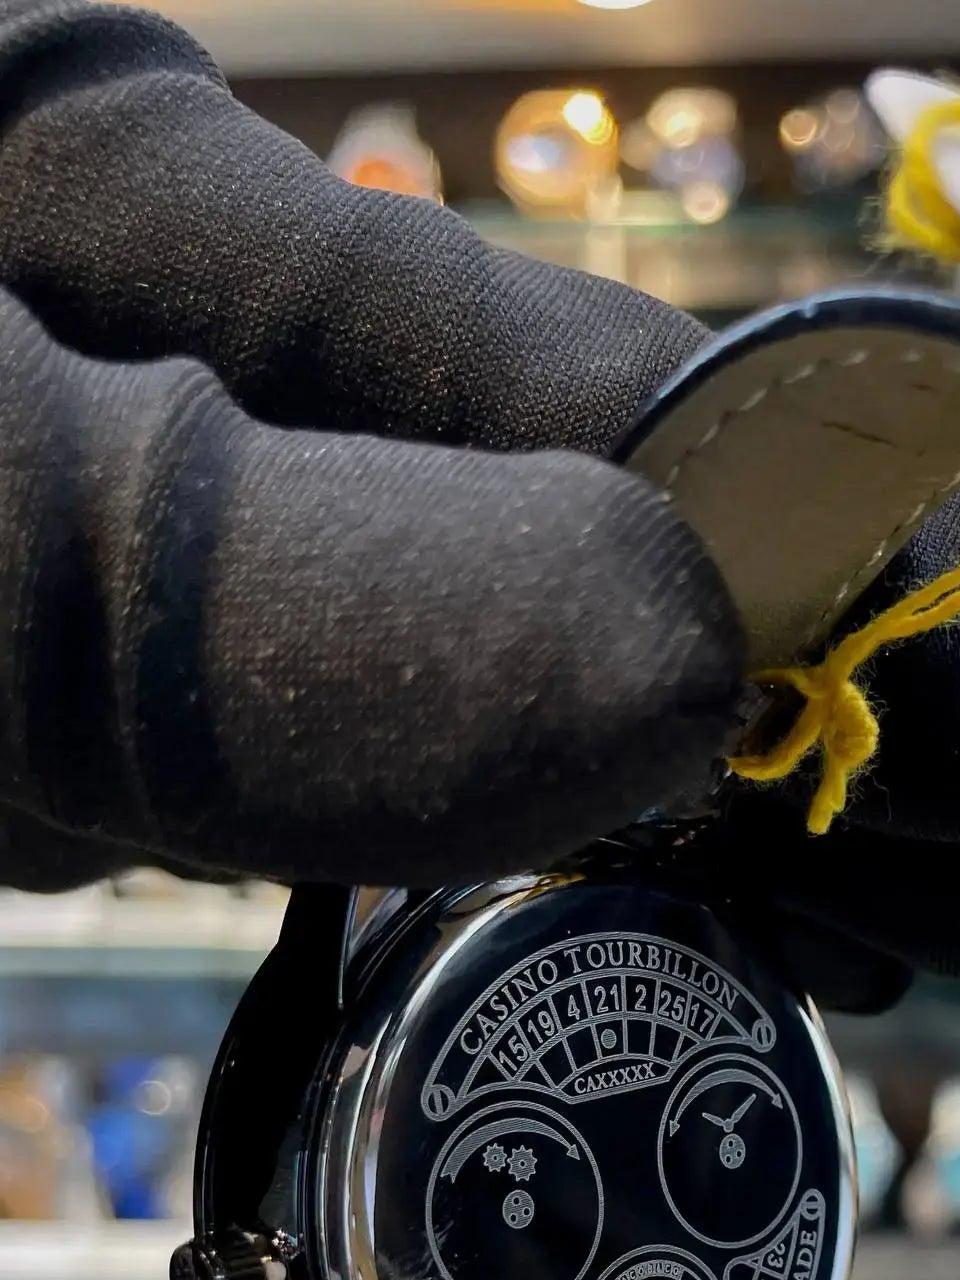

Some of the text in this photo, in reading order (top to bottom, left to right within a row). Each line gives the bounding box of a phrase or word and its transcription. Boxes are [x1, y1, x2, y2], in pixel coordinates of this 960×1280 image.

[461, 941, 740, 1055] CASINO TOURBILLON
[498, 983, 715, 1071] 15 19 4 21 2 25 17
[574, 1062, 656, 1094] CAXXXXX
